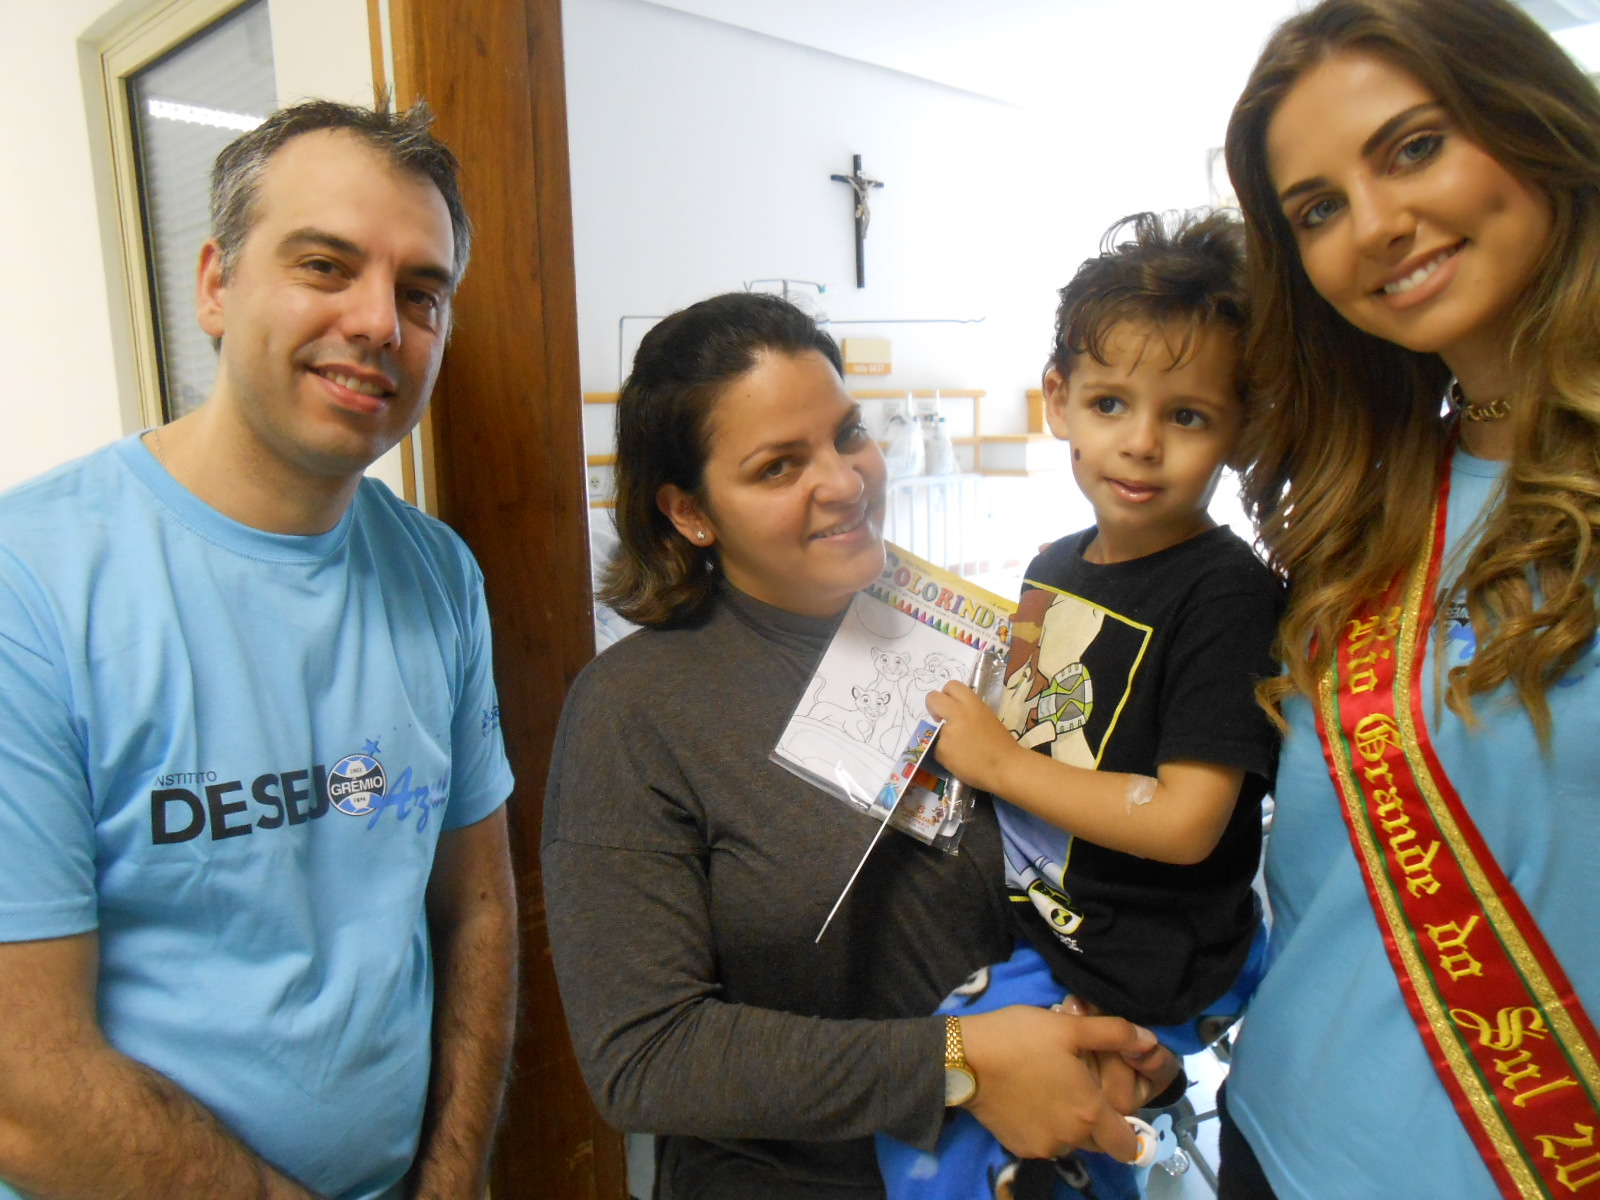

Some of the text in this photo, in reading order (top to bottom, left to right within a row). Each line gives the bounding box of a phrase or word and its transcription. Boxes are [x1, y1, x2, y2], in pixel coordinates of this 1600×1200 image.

[1346, 606, 1403, 695] Rio
[331, 775, 384, 796] GRÊMIO
[1354, 713, 1442, 899] Grande
[1423, 914, 1484, 982] do
[1449, 1006, 1579, 1108] Sul
